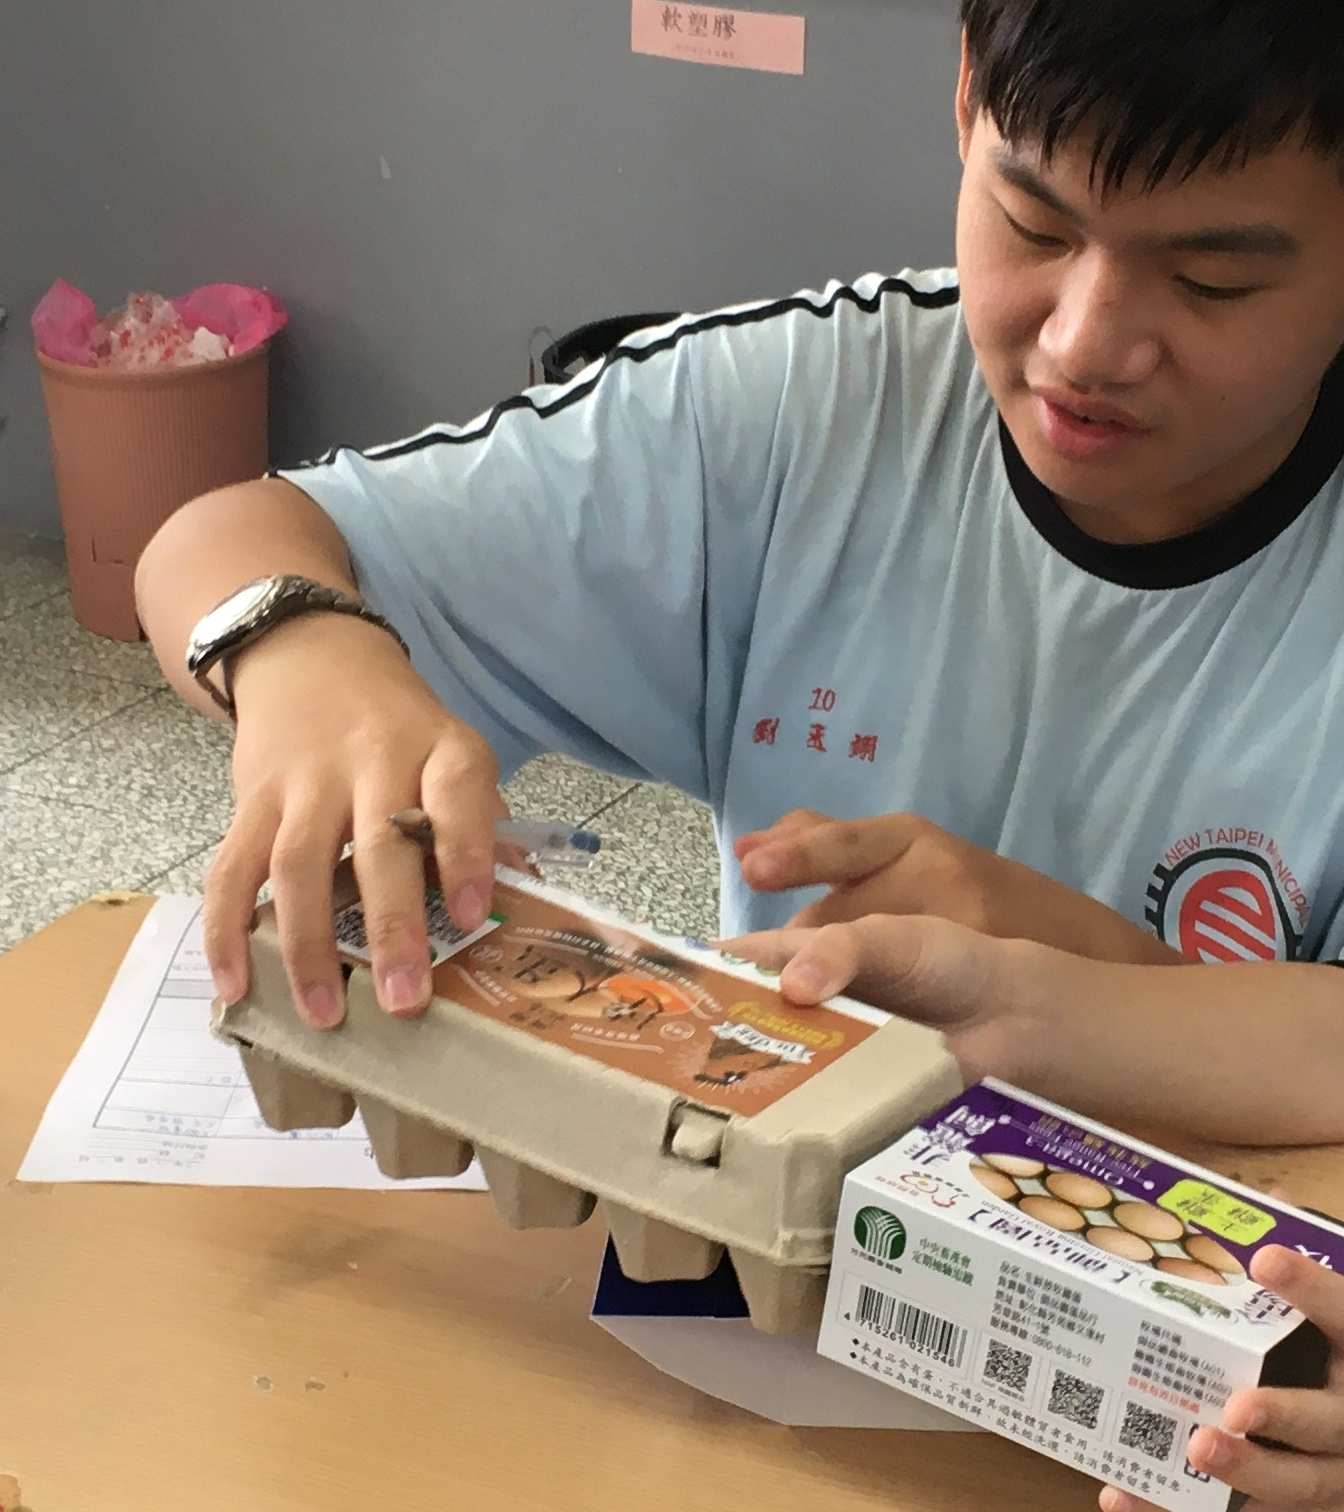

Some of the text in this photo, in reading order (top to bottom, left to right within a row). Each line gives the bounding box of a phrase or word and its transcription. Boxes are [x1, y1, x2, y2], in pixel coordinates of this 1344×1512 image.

[660, 4, 737, 41] 軟塑膠
[807, 687, 836, 712] 10
[1164, 832, 1200, 866] NEW
[1204, 827, 1264, 847] TAIPEI
[859, 1319, 904, 1345] 715261
[909, 1341, 956, 1367] 021546
